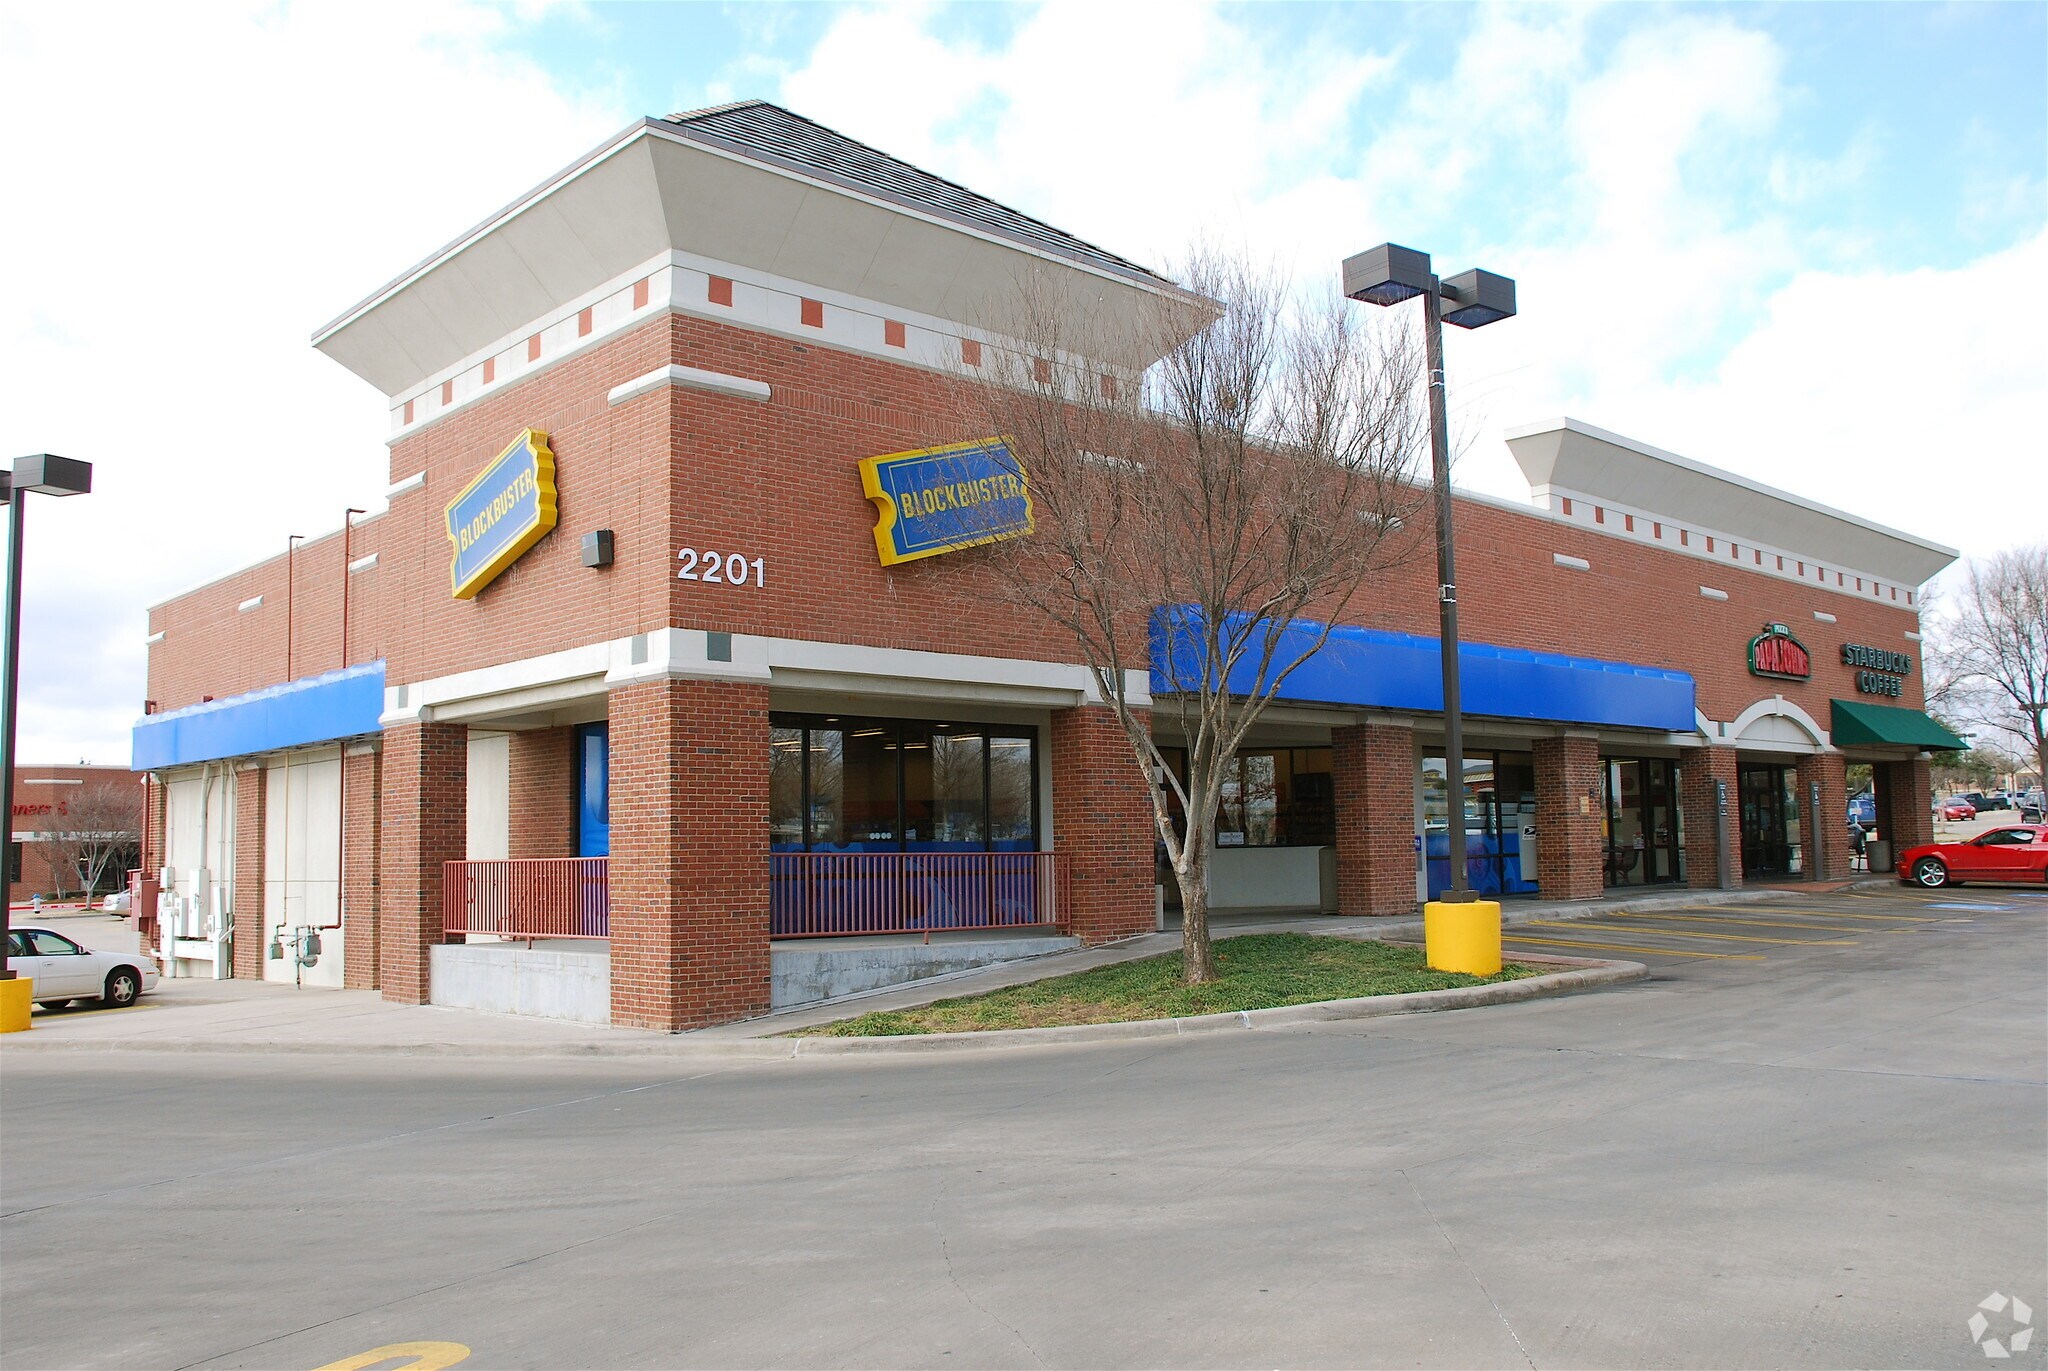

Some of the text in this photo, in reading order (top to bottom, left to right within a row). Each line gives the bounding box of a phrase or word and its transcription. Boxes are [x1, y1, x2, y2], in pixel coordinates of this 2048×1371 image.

[460, 467, 534, 553] BLOCKBUSTER
[900, 473, 1021, 519] BLOCKBUSTER
[677, 547, 765, 588] 2201
[1774, 624, 1789, 635] PIZZA
[1755, 639, 1780, 672] PAPA
[1844, 642, 1912, 674] STARBUCKS
[1860, 670, 1903, 697] COFFEE
